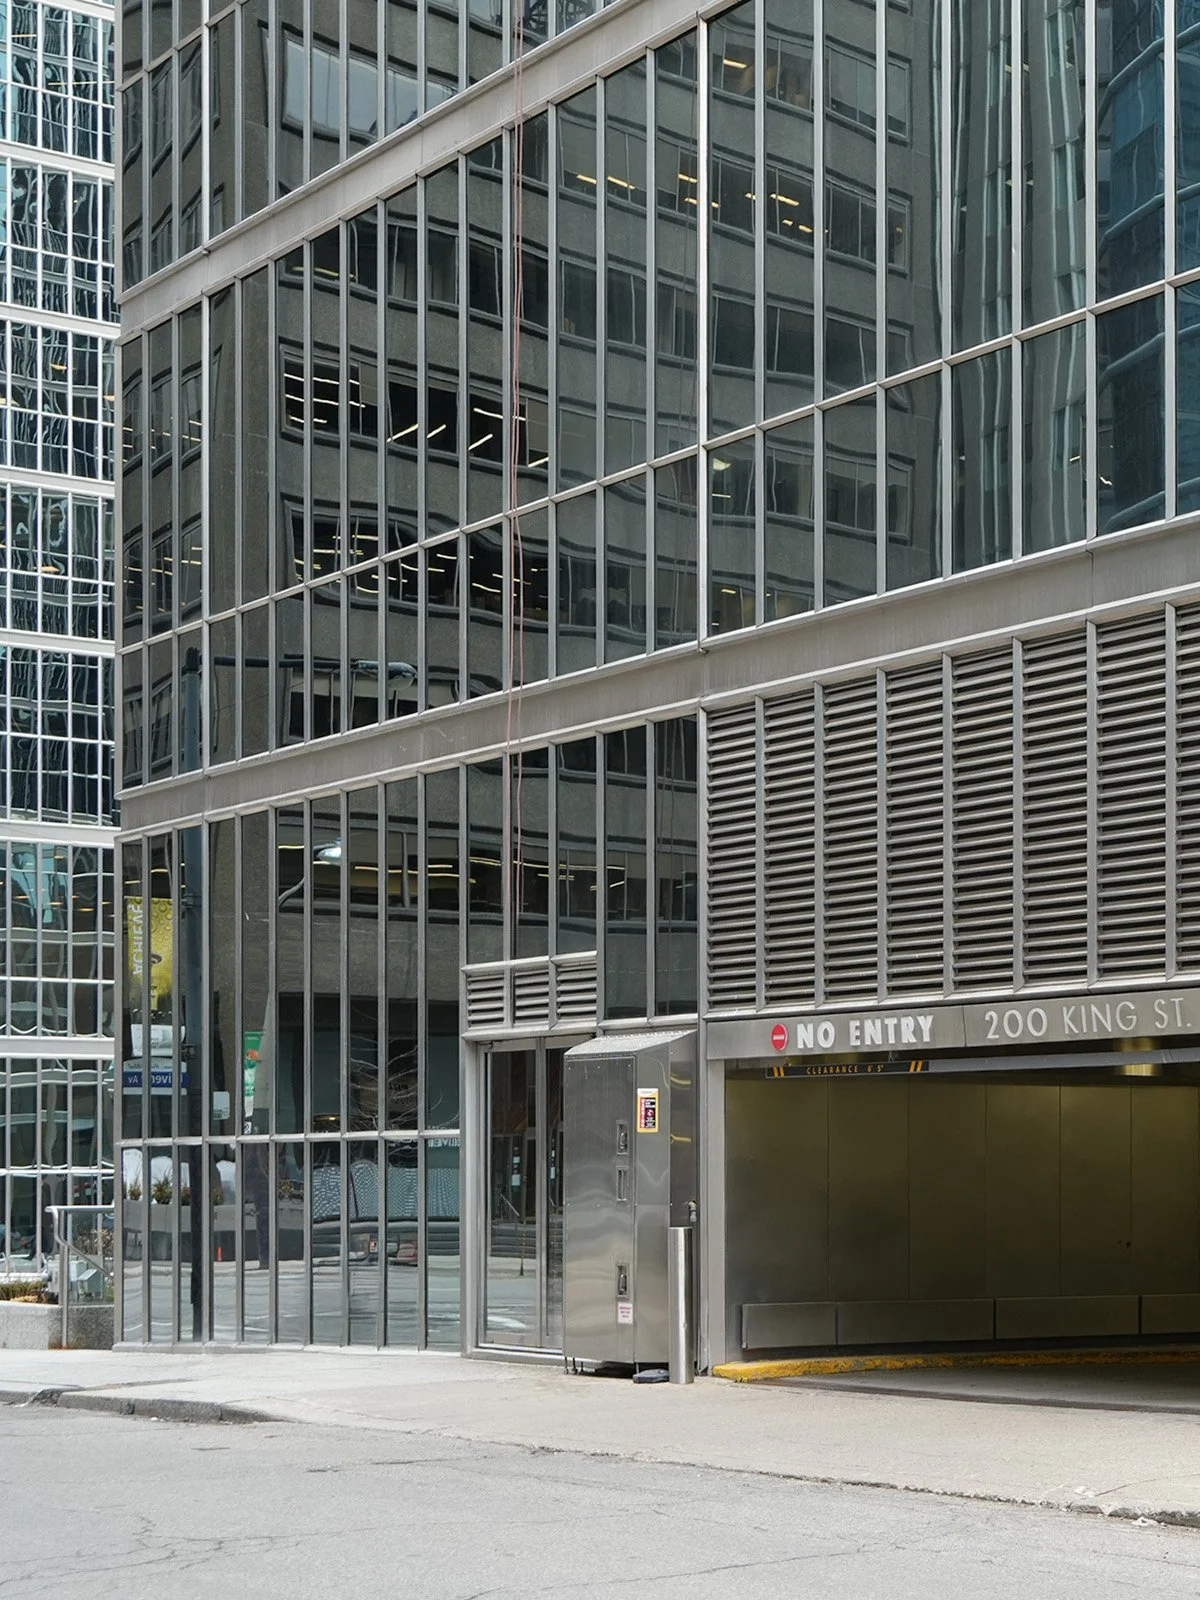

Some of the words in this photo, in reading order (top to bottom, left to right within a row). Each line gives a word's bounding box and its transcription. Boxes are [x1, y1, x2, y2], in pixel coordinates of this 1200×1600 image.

[796, 1020, 836, 1050] NO
[849, 1014, 934, 1047] ENTRY
[984, 1006, 1049, 1040] 200
[1062, 1001, 1137, 1035] KING
[1154, 996, 1193, 1029] ST.
[806, 1064, 859, 1075] CLEARANCE
